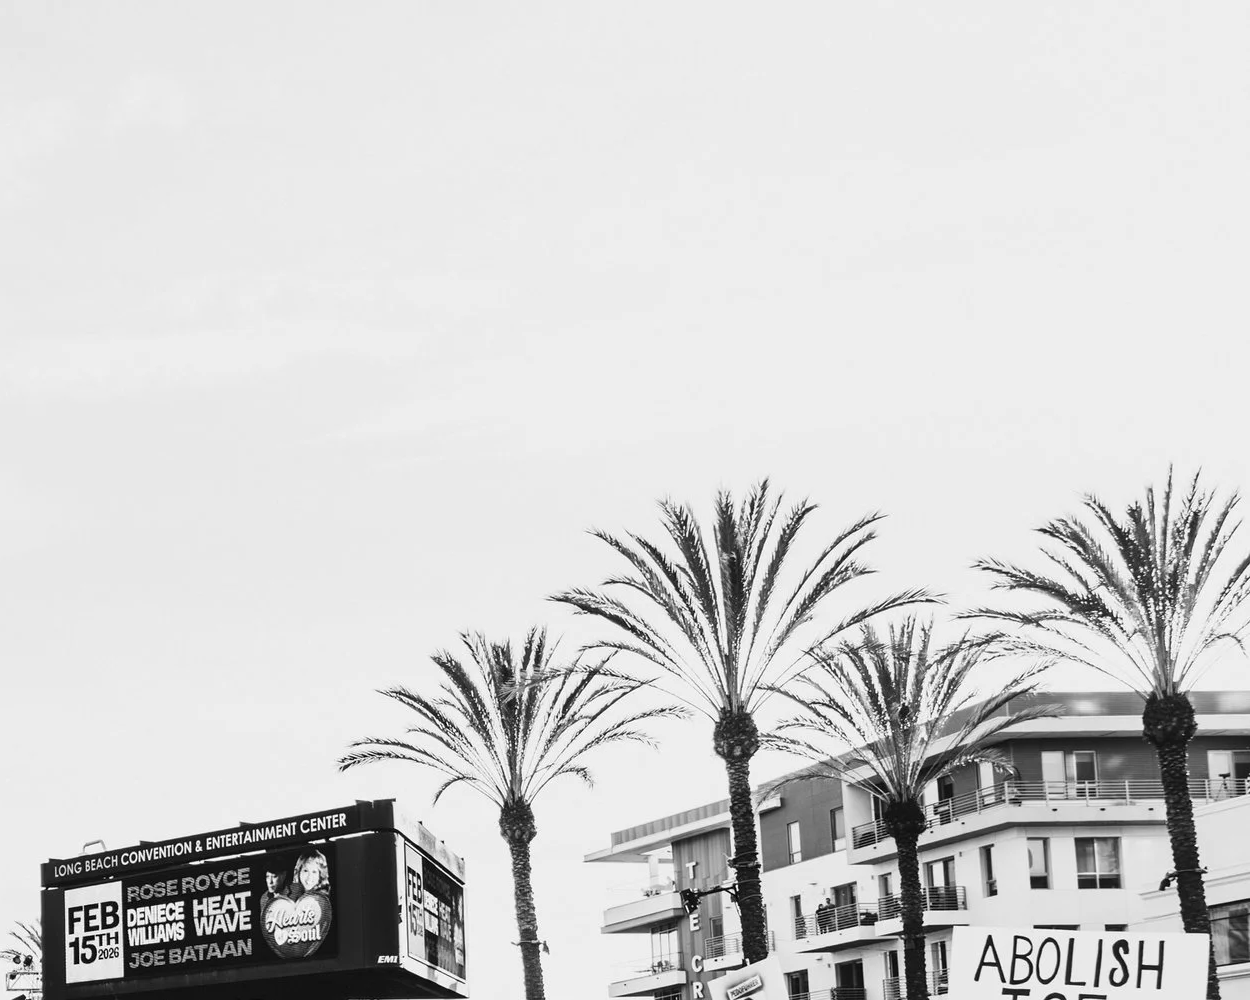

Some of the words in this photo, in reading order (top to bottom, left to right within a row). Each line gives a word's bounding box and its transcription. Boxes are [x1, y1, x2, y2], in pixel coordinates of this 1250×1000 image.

[54, 861, 82, 877] LONG
[85, 855, 118, 871] BEACH
[120, 841, 192, 865] CONVENTION
[195, 840, 203, 852] &
[206, 822, 297, 850] ENTERTAINMENT
[300, 813, 347, 833] CENTER
[127, 879, 178, 902] ROSE
[181, 868, 250, 894] ROYCE
[686, 861, 700, 932] TE
[68, 900, 120, 935] FEB
[127, 901, 185, 927] DENIECE
[193, 890, 251, 918] HEAT
[127, 921, 185, 946] WILLIAMS
[193, 911, 252, 936] WAVE
[266, 909, 315, 932] Hearts
[288, 924, 321, 944] Soul
[69, 931, 120, 965] 15TH
[98, 947, 120, 960] 2026
[129, 948, 166, 969] JOE
[169, 938, 252, 965] BATAAN
[974, 934, 1165, 990] ABOLISH
